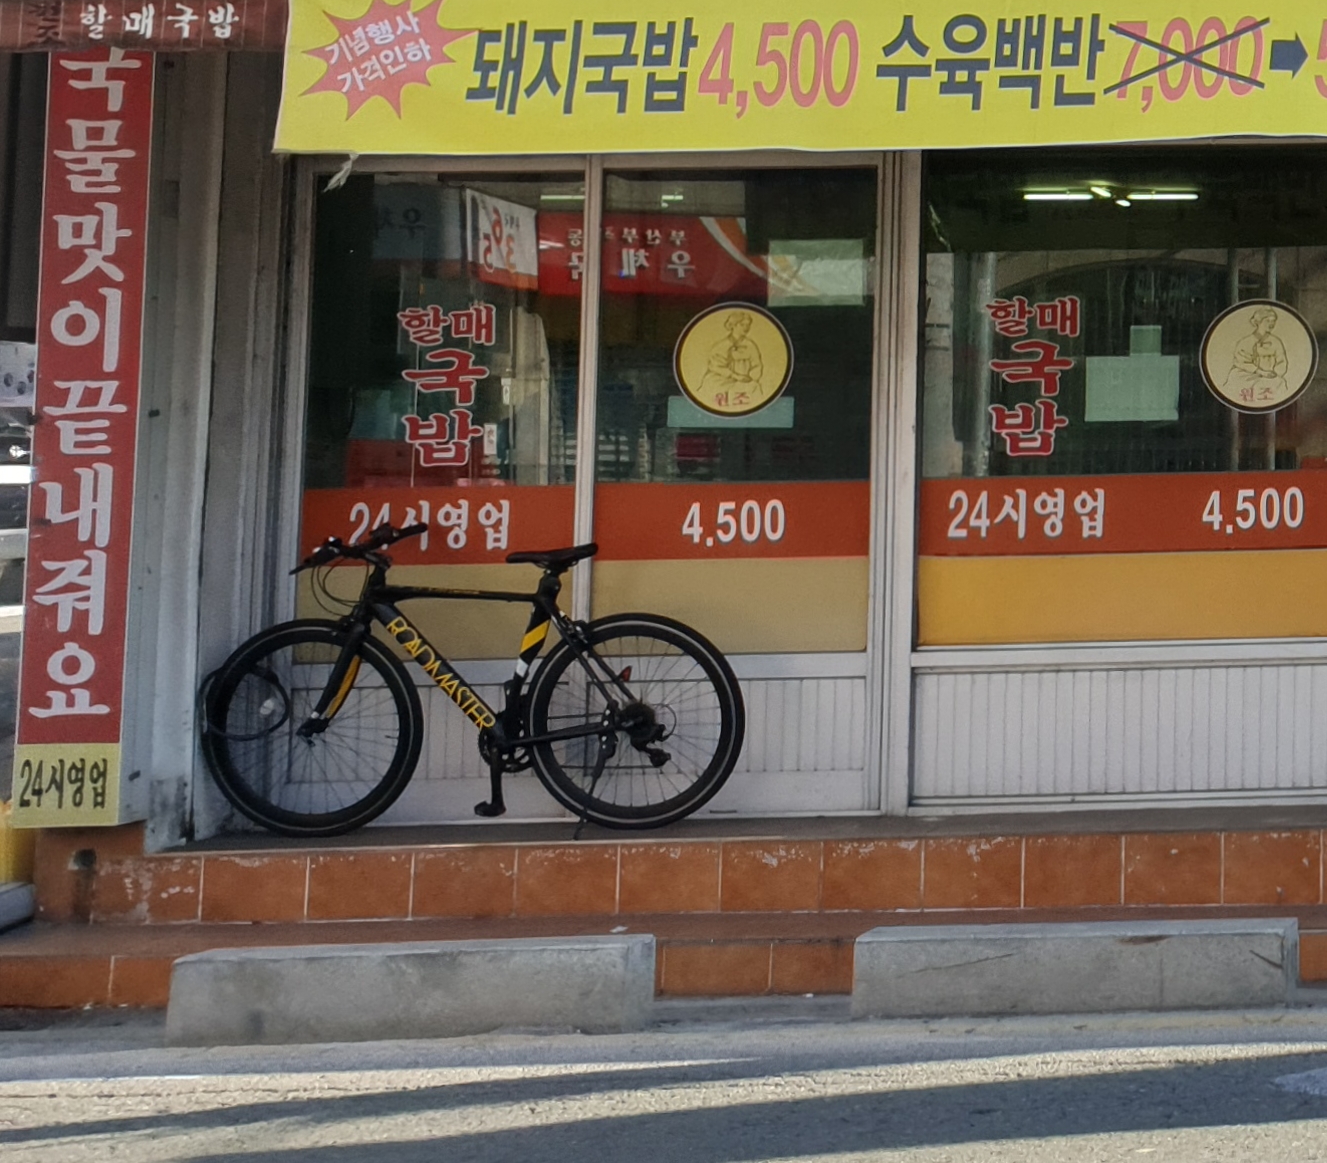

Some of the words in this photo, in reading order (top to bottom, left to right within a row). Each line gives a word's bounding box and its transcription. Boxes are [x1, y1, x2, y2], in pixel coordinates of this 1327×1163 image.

[80, 3, 240, 38] 할매국밥
[325, 10, 421, 66] 기념행사
[337, 37, 433, 95] 가격인하
[465, 16, 699, 115] 돼지국밥
[698, 18, 859, 119] 4,500
[876, 13, 1105, 112] 수육백반
[715, 391, 750, 407] 원조
[946, 487, 1106, 540] 24시영업
[18, 757, 108, 811] 24시영업
